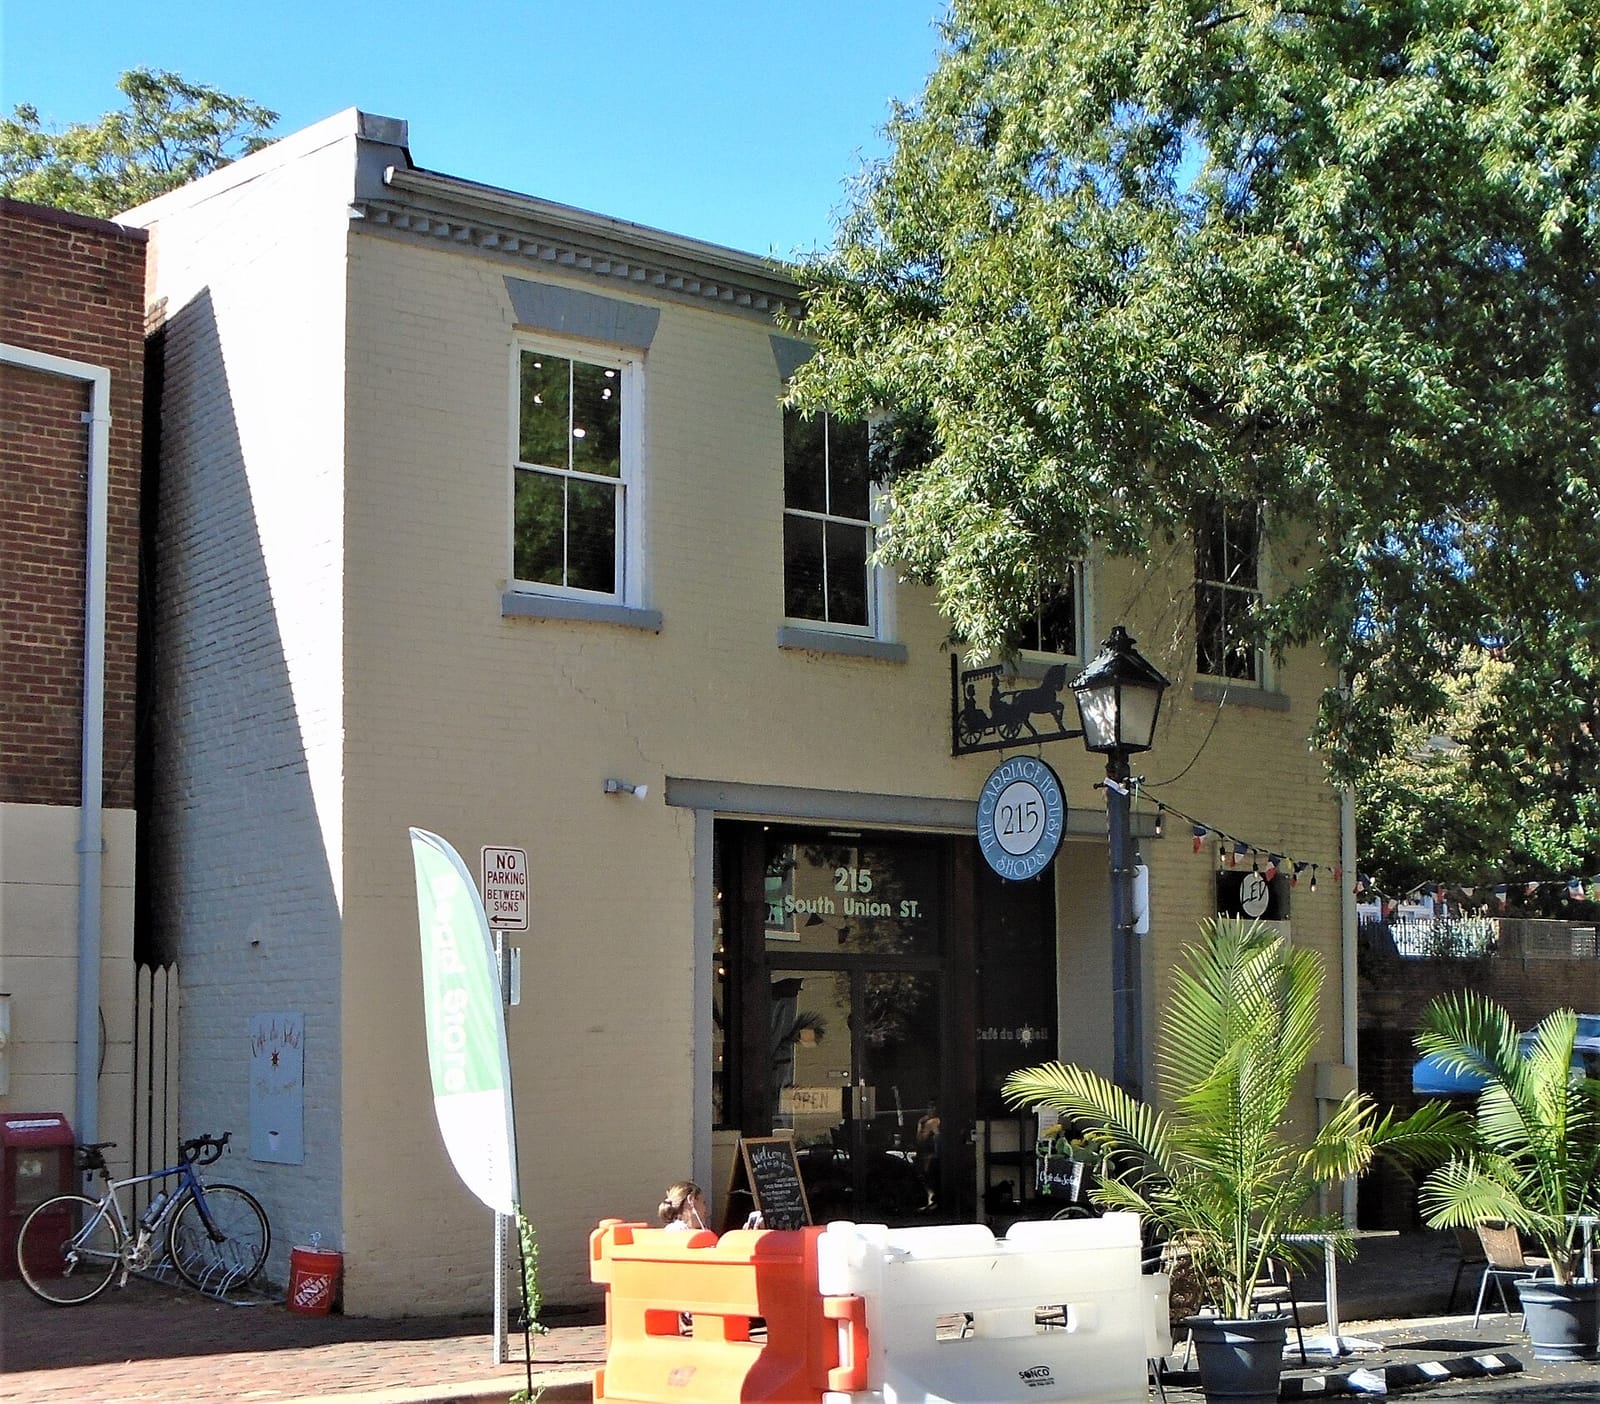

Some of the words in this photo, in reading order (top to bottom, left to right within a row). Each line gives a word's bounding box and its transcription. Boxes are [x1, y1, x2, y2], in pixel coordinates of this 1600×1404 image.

[982, 761, 1044, 815] CARRIAGE
[1001, 801, 1039, 836] 215
[1039, 776, 1061, 844] HOUSE
[981, 824, 995, 853] THE
[496, 854, 516, 870] NO
[995, 849, 1047, 877] SHOPS
[487, 871, 525, 886] PARKING
[834, 866, 873, 893] 215
[487, 889, 526, 901] BETWEEN
[494, 901, 519, 912] SIGNS
[784, 895, 835, 915] South
[843, 897, 891, 917] Union
[900, 900, 922, 918] ST.
[443, 987, 469, 1092] Store
